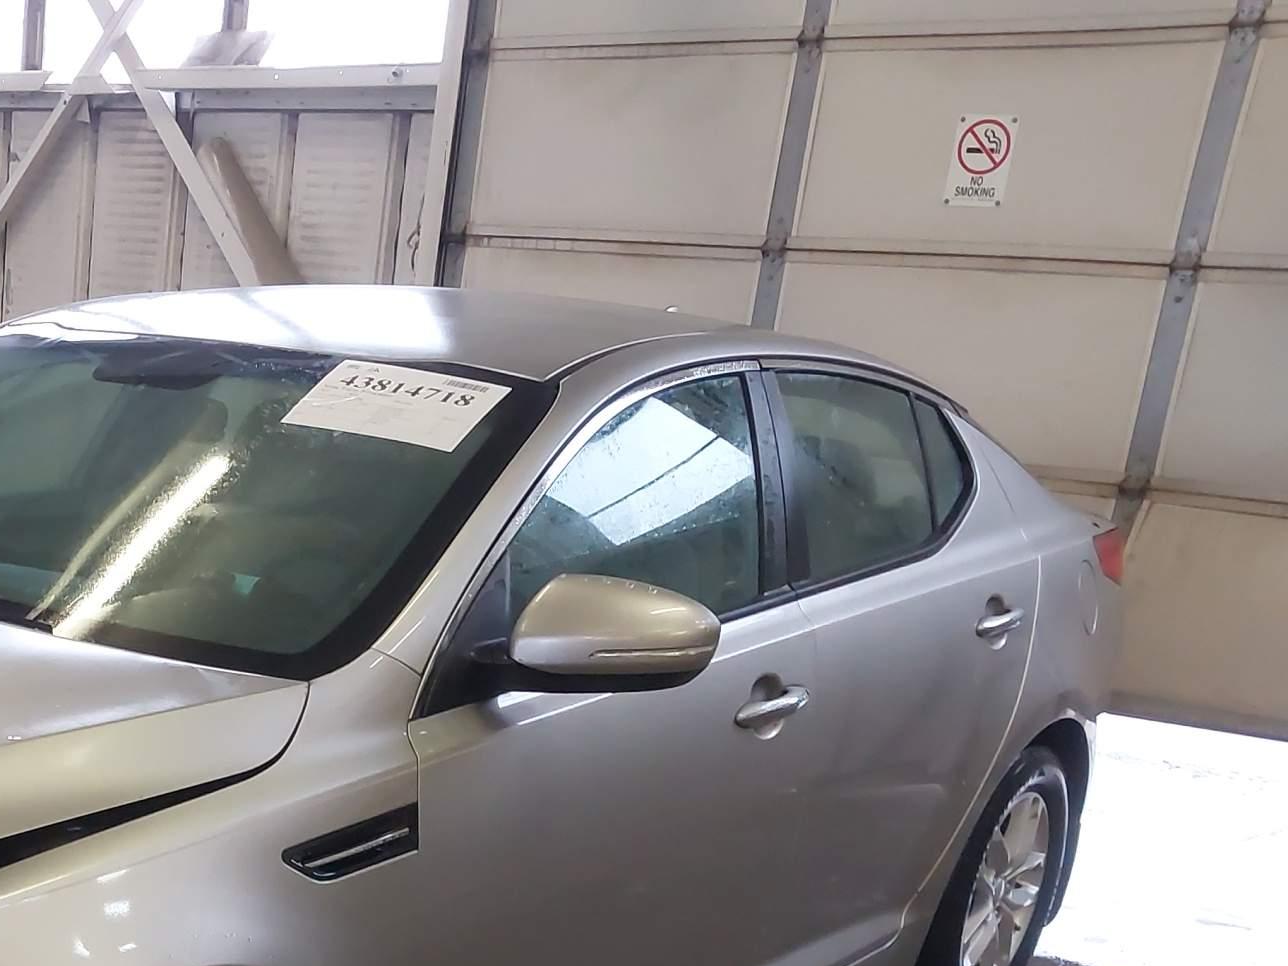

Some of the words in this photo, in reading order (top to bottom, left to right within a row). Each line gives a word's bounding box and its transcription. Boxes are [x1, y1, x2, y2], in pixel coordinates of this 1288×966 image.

[970, 176, 984, 186] NO
[954, 186, 995, 198] SMOKING
[339, 374, 475, 407] 43814718
